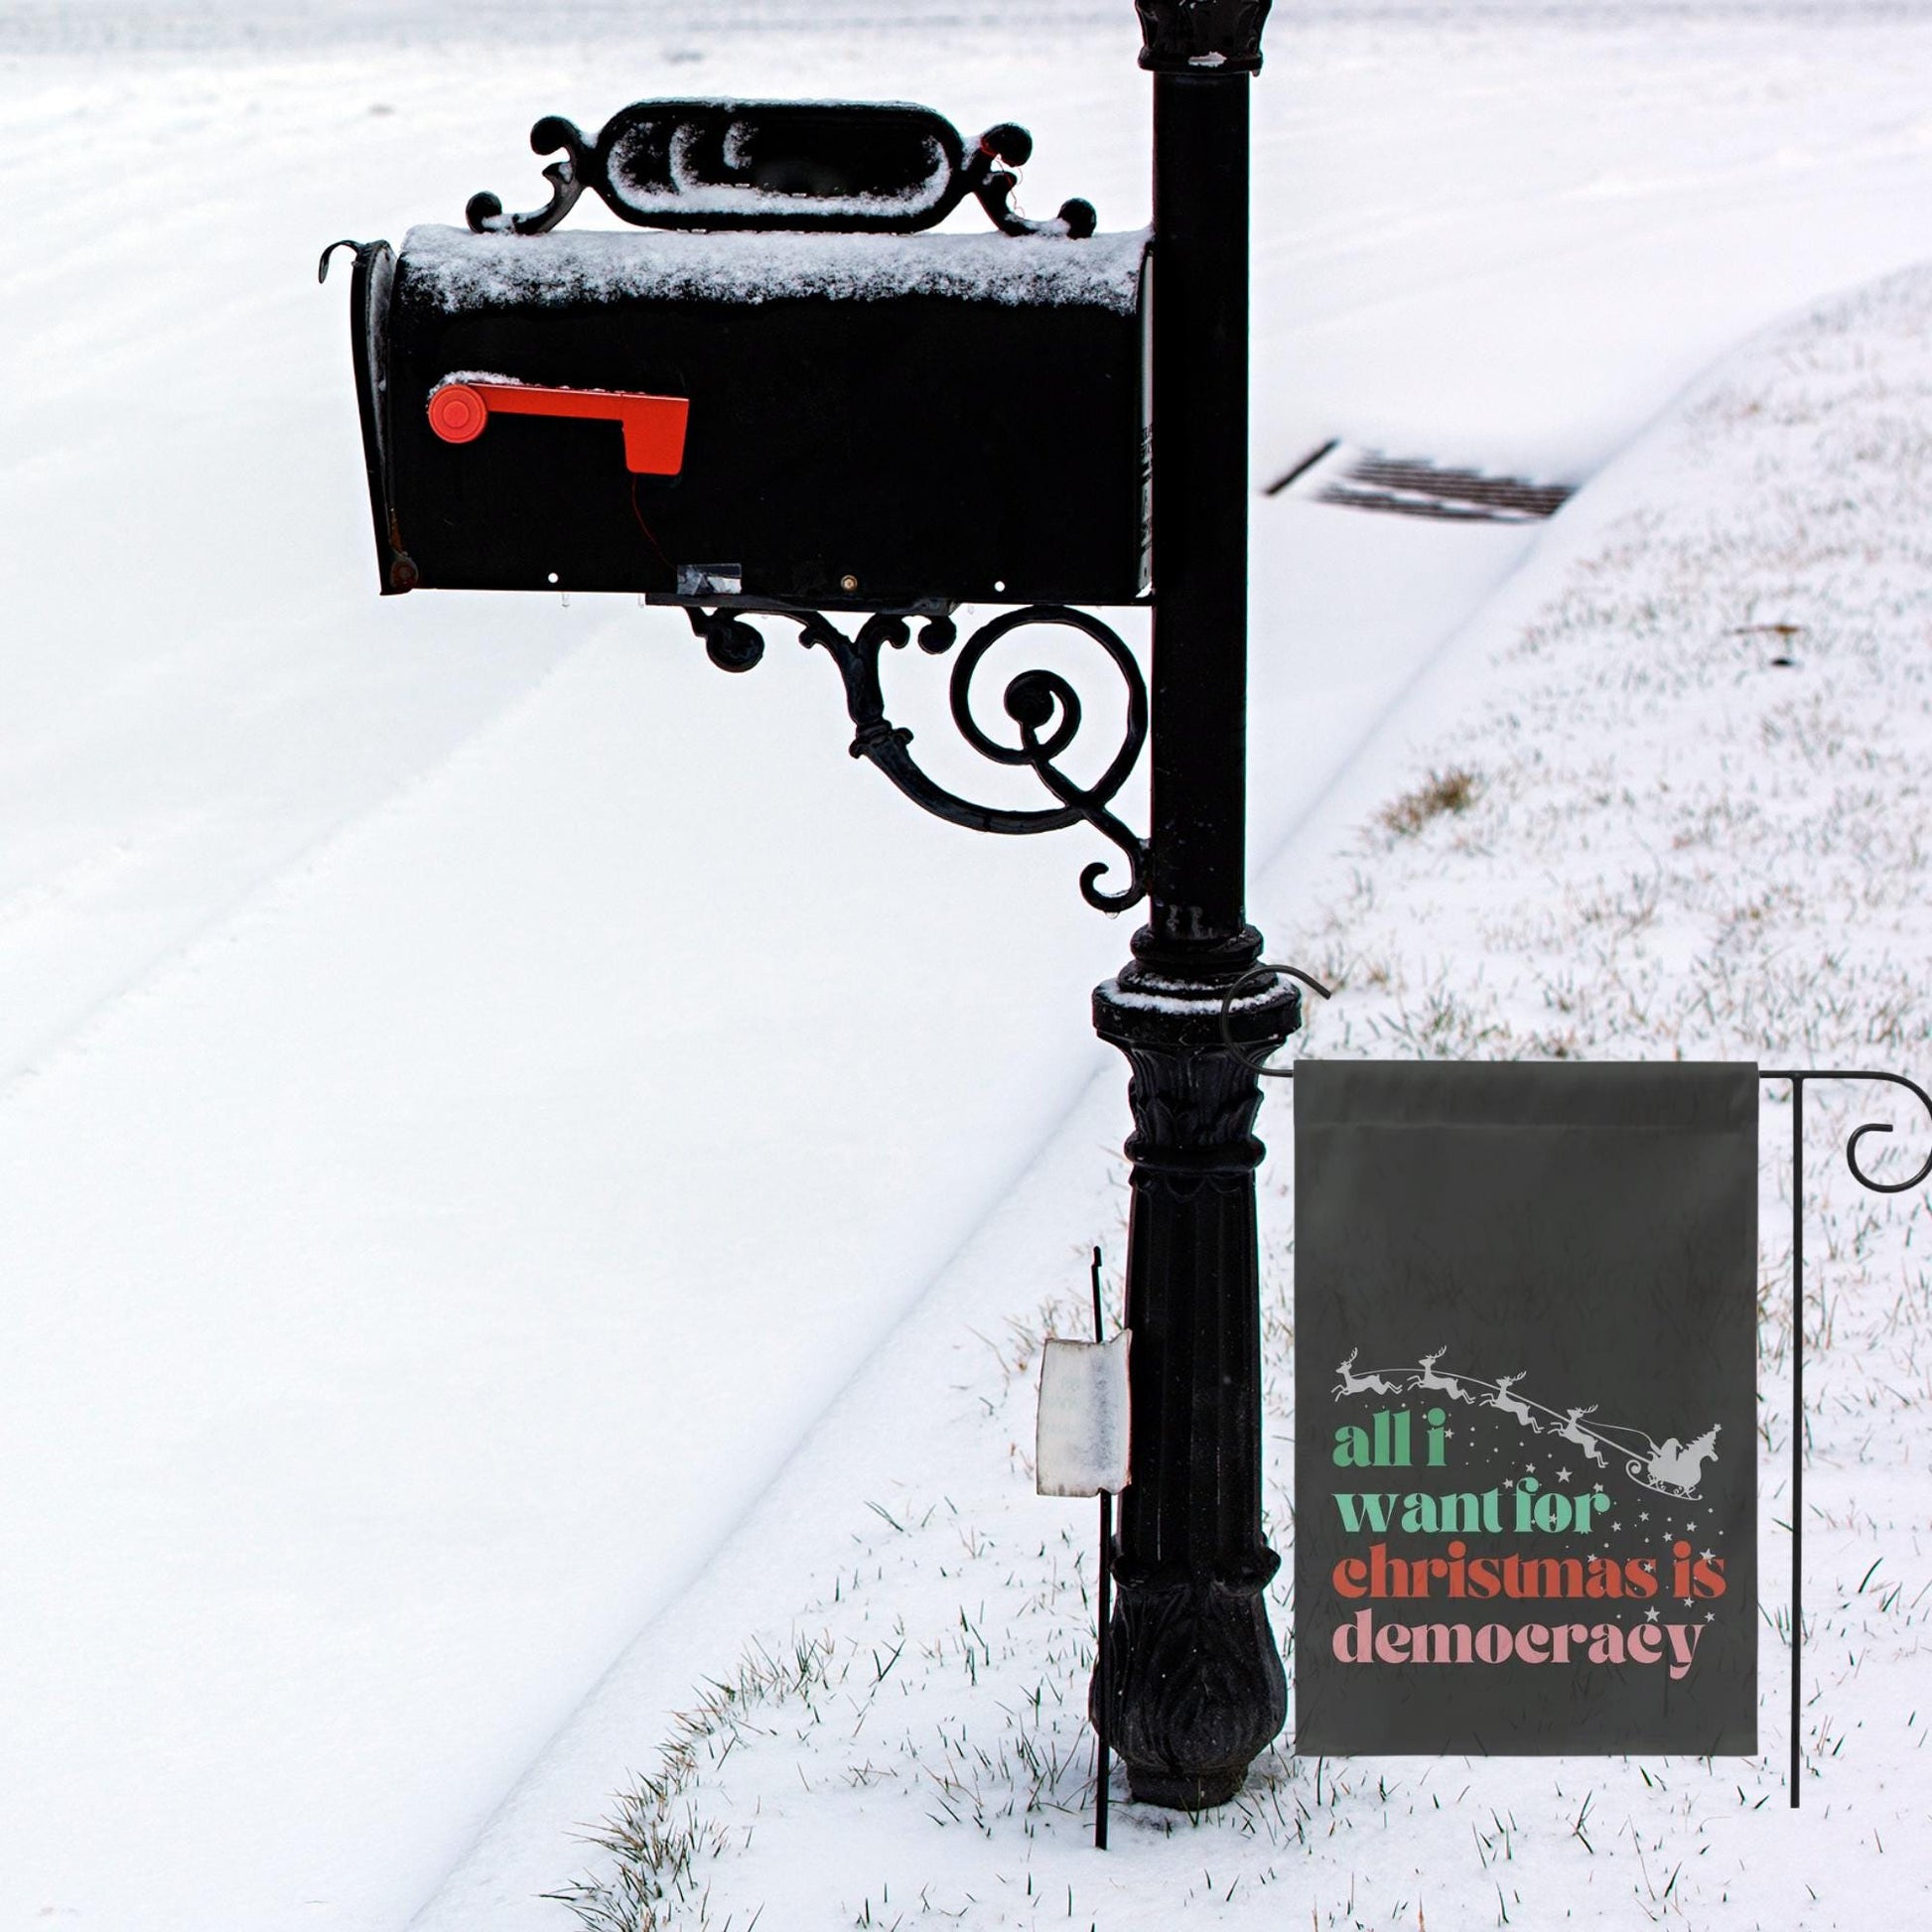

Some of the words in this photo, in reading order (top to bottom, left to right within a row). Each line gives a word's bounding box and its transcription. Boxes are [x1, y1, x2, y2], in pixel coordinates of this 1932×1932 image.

[1332, 1409, 1413, 1466] all
[1427, 1408, 1447, 1466] i
[1331, 1487, 1503, 1533] want
[1513, 1476, 1610, 1534] for
[1332, 1541, 1658, 1598] christmas
[1672, 1541, 1727, 1598] is
[1332, 1608, 1706, 1680] democracy
